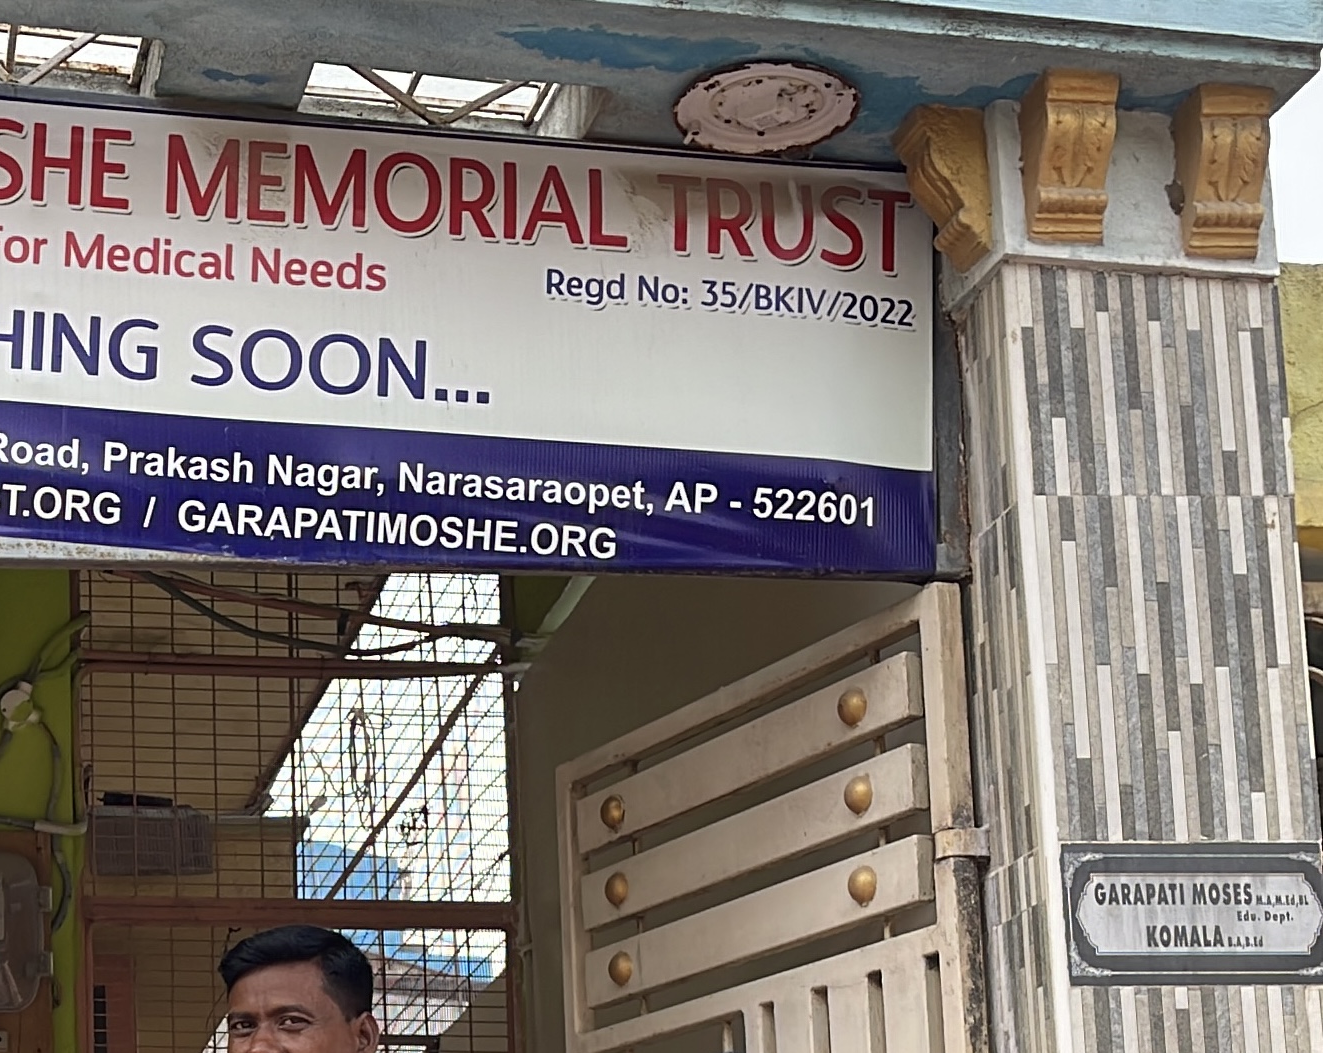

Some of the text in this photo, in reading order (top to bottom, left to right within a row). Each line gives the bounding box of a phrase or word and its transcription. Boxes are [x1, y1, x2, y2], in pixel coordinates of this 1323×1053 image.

[165, 131, 628, 249] MEMORIAL
[672, 172, 913, 274] TRUST
[63, 229, 235, 281] Medical
[250, 247, 387, 291] Needs
[545, 268, 625, 307] Regd
[637, 275, 689, 305] No:
[190, 325, 491, 405] SOON...
[103, 440, 254, 485] Prakash
[266, 453, 386, 499] Nagar,
[397, 461, 655, 519] Narasaraopet,
[665, 481, 719, 514] AP
[752, 487, 878, 528] 522601
[142, 494, 155, 529] /
[178, 499, 618, 562] GARAPATIMOSHE.ORG
[1094, 882, 1185, 906] GARAPATI
[1192, 882, 1253, 906] MOSES
[1237, 910, 1294, 924] Edu. Dept.
[1146, 924, 1225, 948] KOMALA
